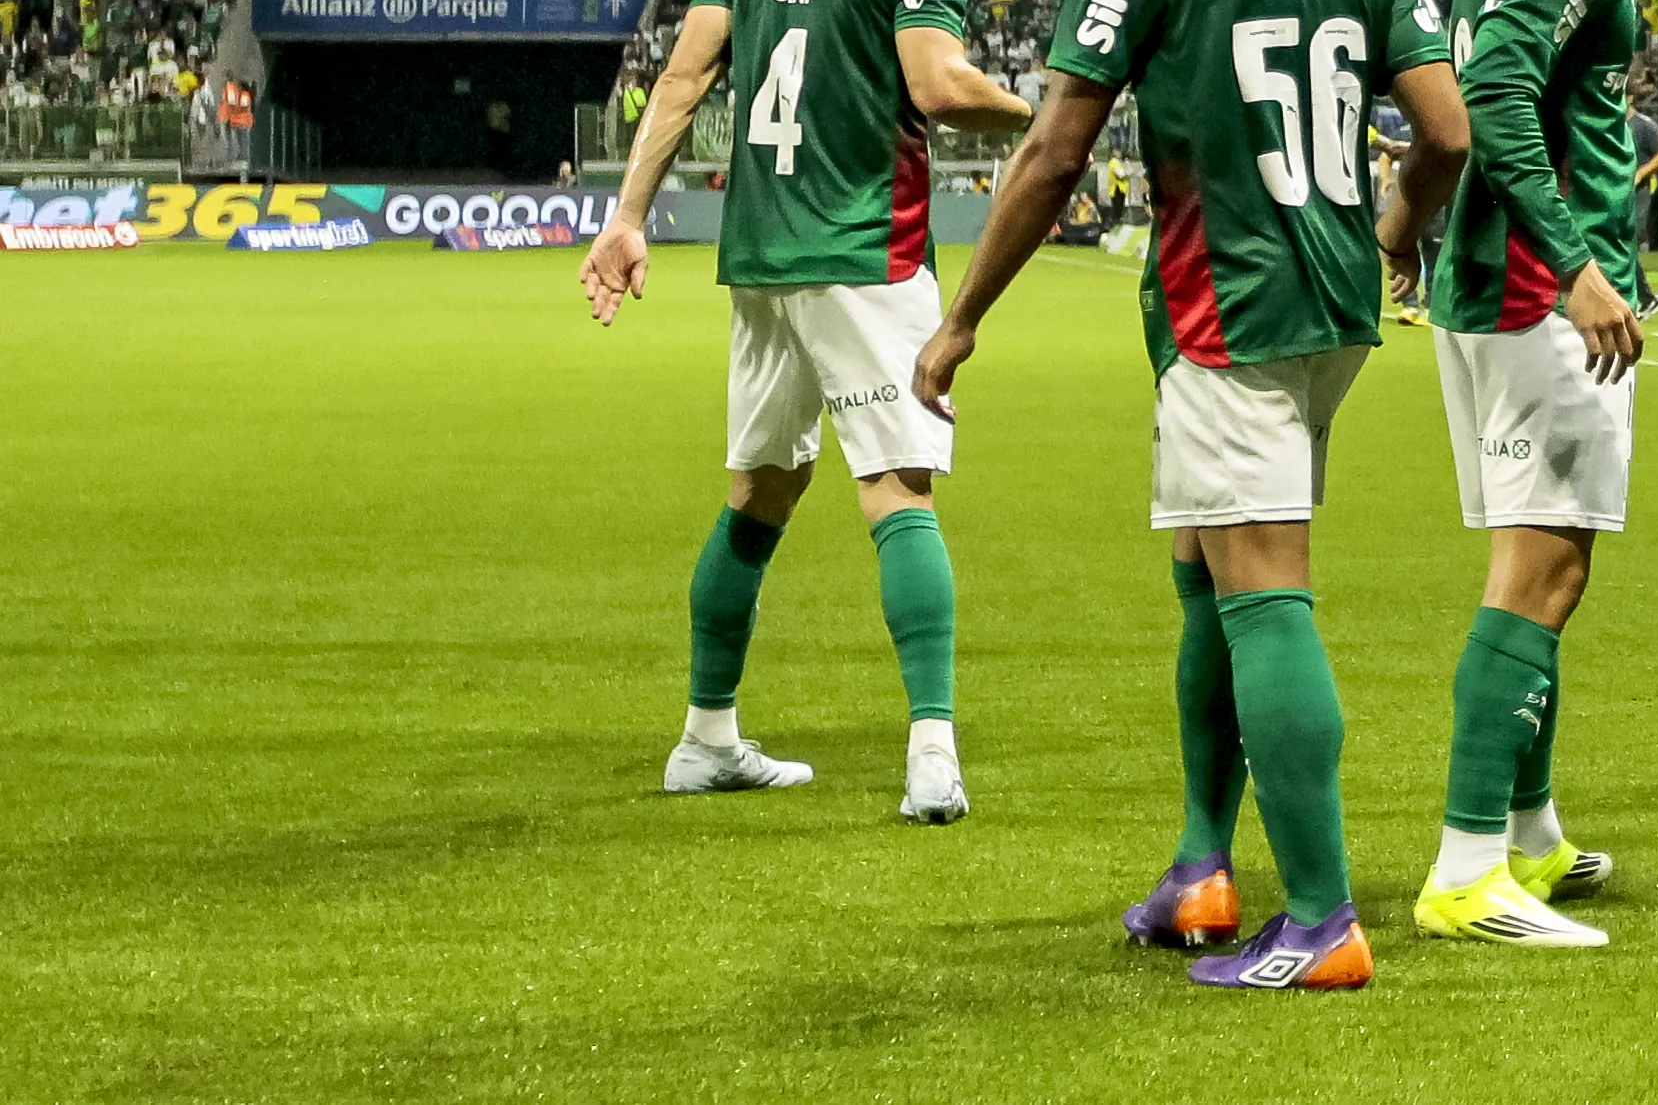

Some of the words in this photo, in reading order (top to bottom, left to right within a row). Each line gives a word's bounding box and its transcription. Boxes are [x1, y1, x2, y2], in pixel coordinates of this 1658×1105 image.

[748, 27, 809, 176] 4
[1232, 16, 1368, 207] 56
[247, 218, 369, 251] sportingbet
